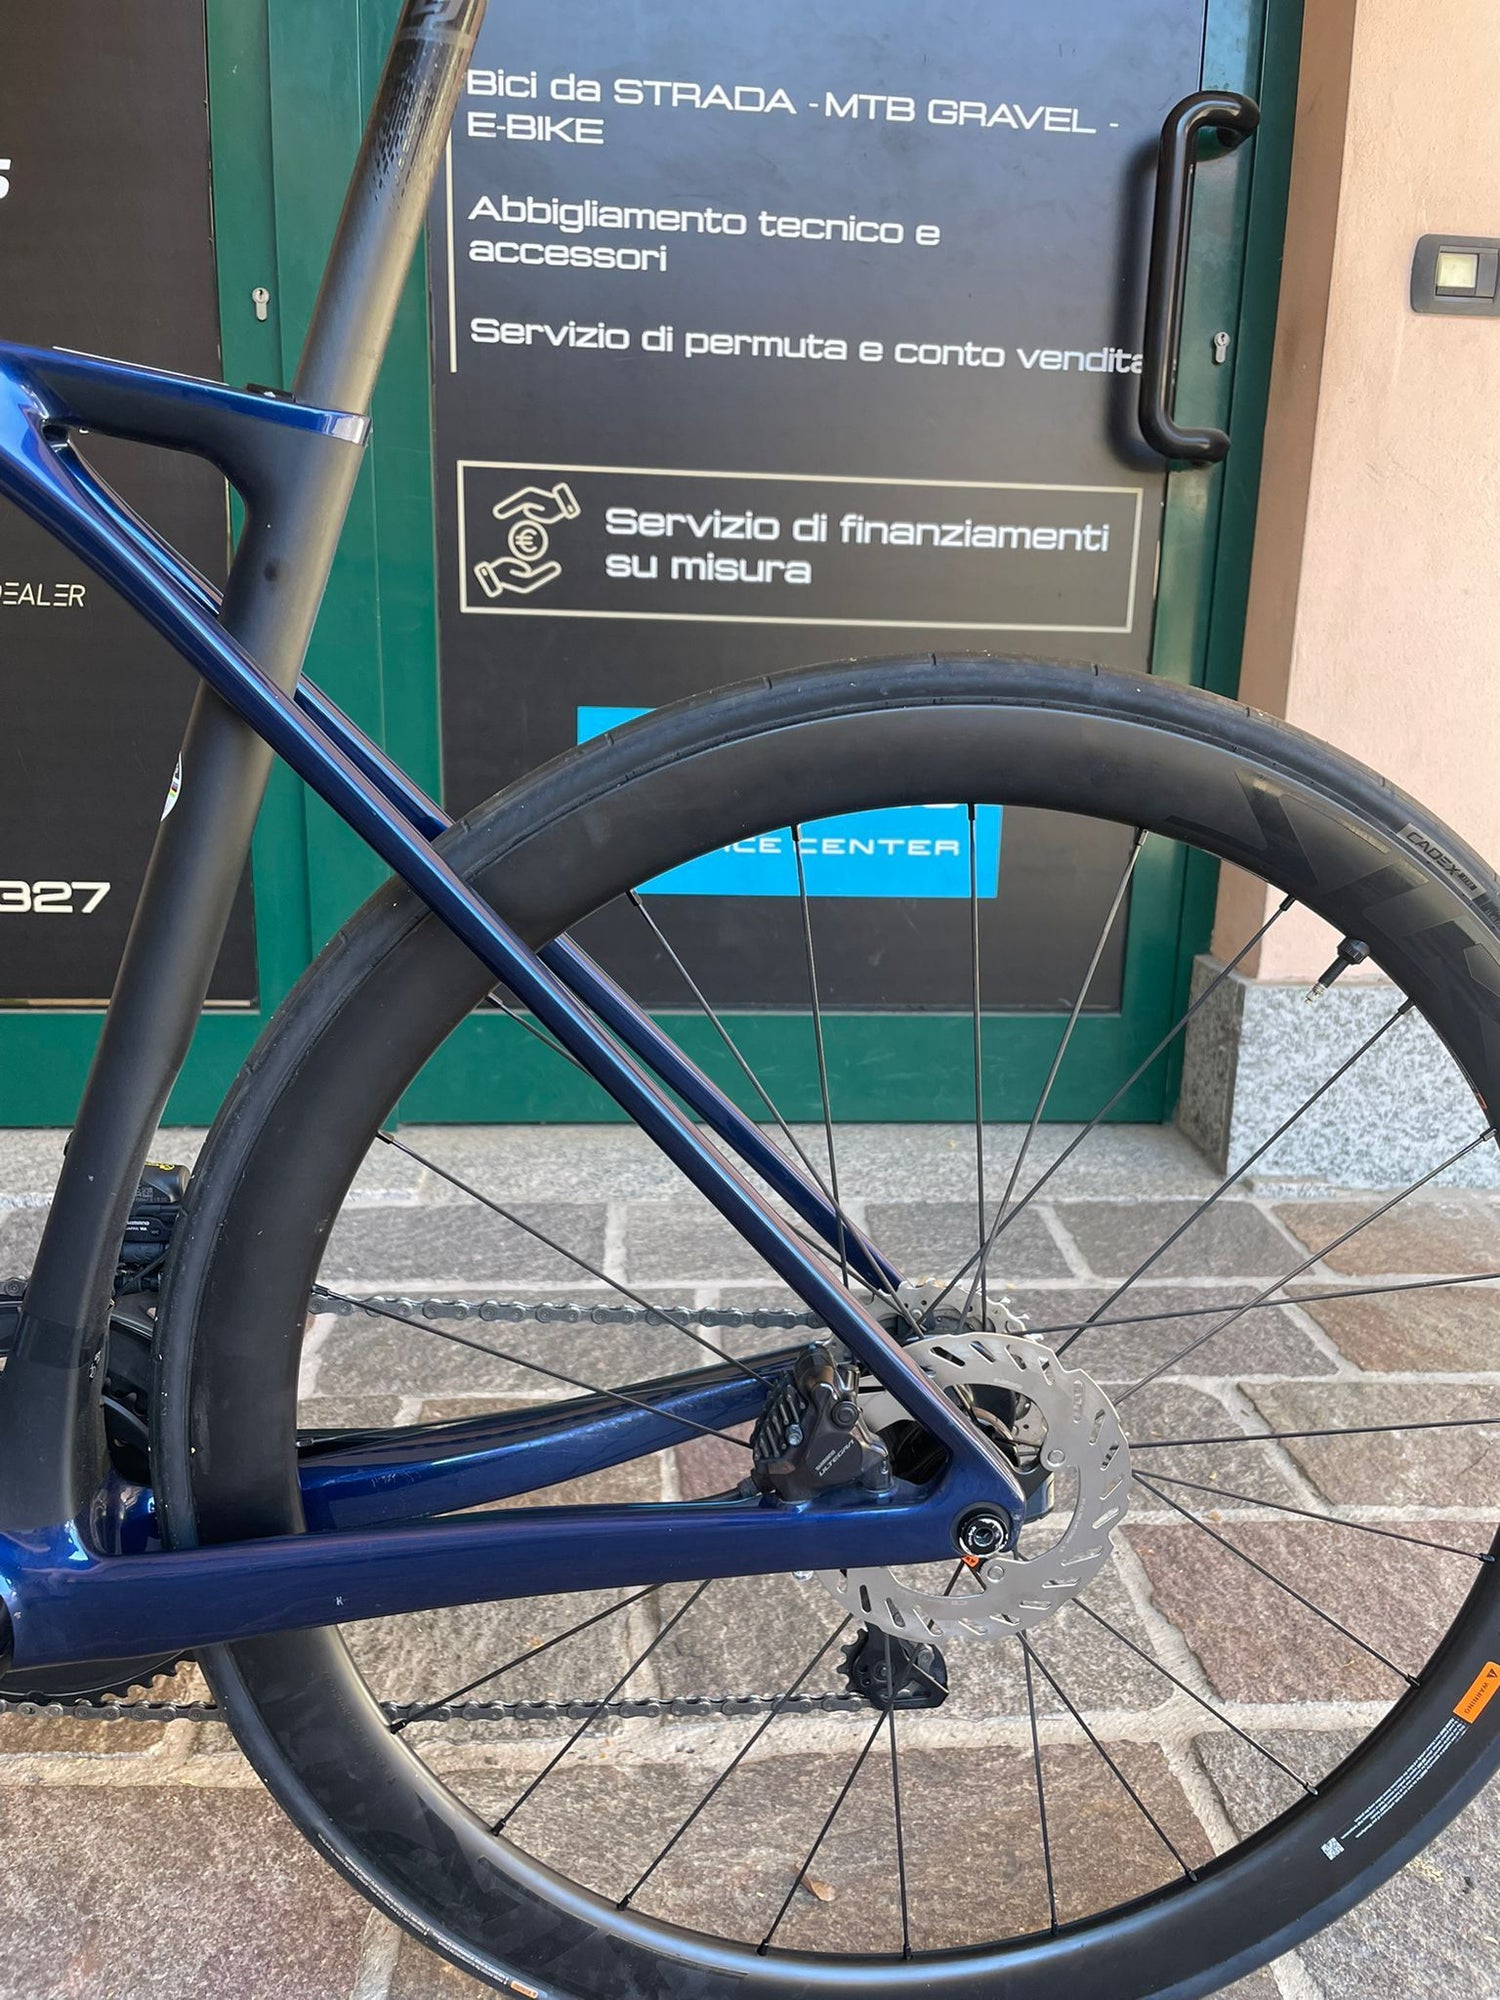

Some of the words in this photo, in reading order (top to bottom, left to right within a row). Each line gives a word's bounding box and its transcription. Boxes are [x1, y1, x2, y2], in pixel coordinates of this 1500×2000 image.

[467, 68, 537, 99] Bici
[550, 72, 601, 103] da
[613, 78, 798, 115] STRADA
[927, 98, 1097, 134] GRAVEL
[467, 111, 605, 145] E-BIKE
[467, 194, 748, 235] Abbigliamento
[757, 210, 905, 244] tecnico
[915, 223, 941, 246] e
[468, 239, 668, 272] accessori
[470, 317, 631, 351] Servizio
[641, 324, 674, 353] di
[684, 332, 848, 361] permuta
[858, 340, 884, 363] e
[894, 341, 1006, 368] conto
[605, 506, 781, 542] Servizio
[792, 512, 828, 544] di
[839, 512, 1110, 552] finanziamenti
[605, 553, 659, 580] su
[670, 552, 812, 585] misura
[0, 581, 87, 608] EALER
[797, 837, 961, 857] CENTER
[1406, 831, 1461, 877] CADEX
